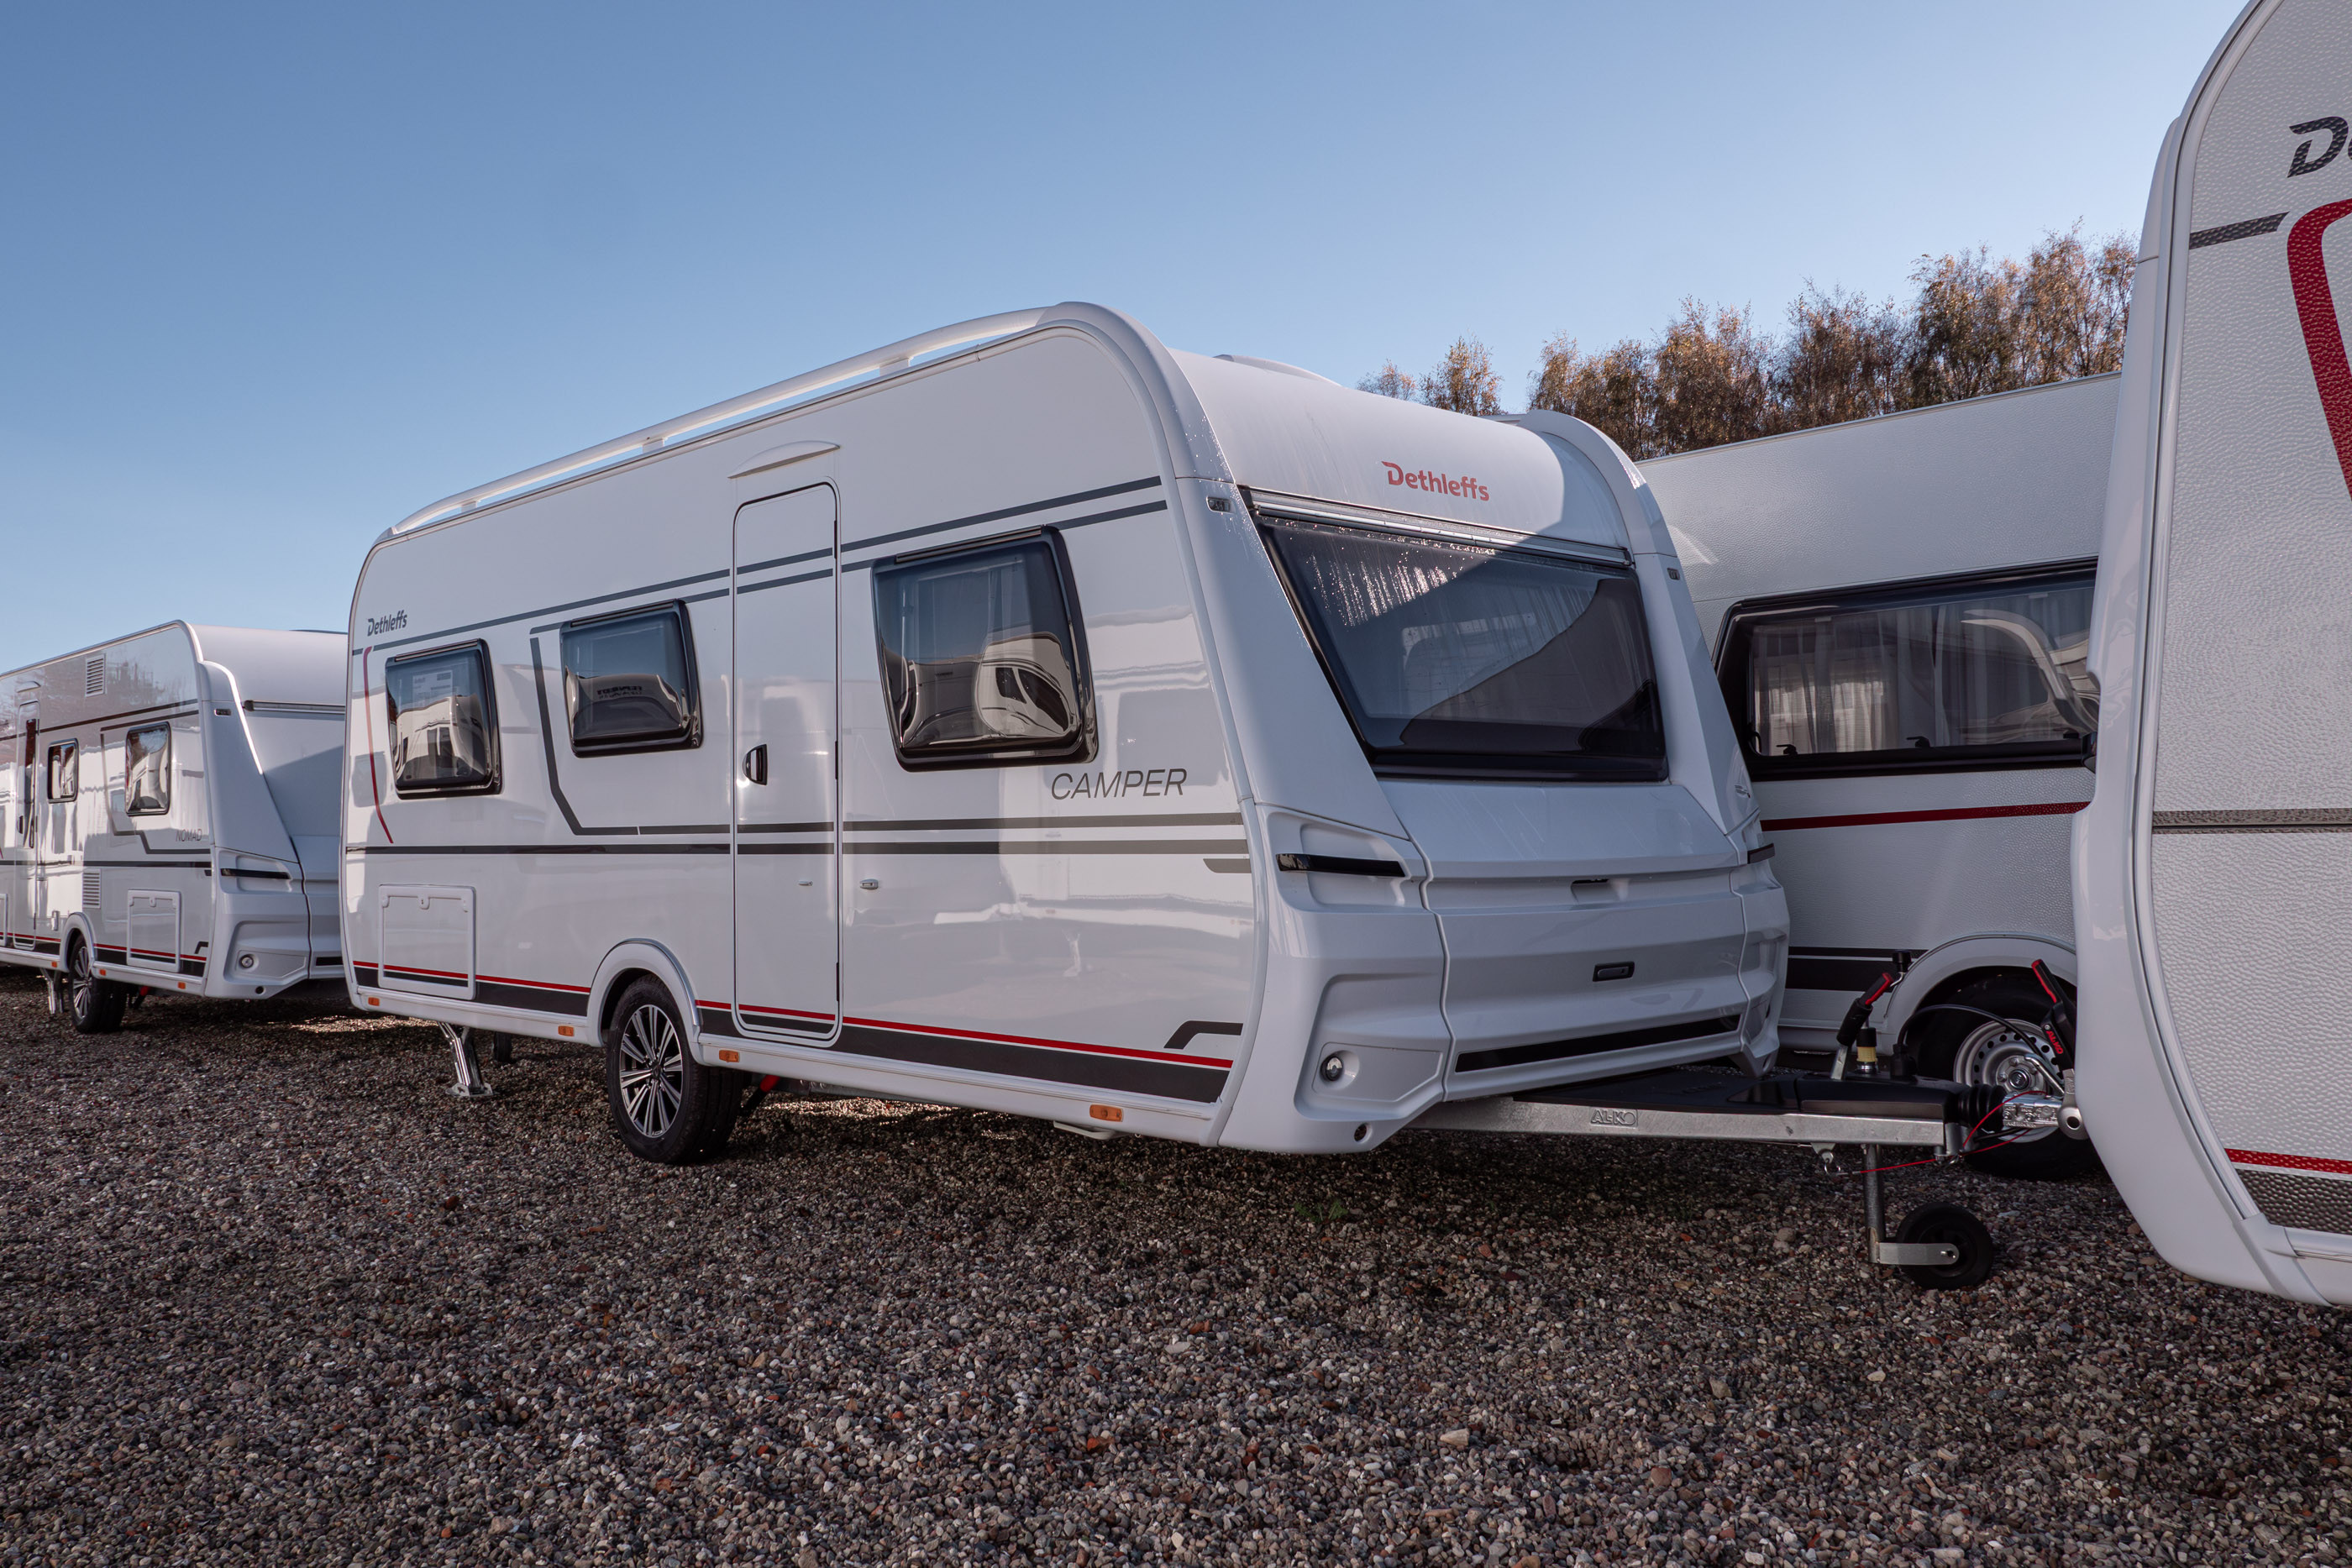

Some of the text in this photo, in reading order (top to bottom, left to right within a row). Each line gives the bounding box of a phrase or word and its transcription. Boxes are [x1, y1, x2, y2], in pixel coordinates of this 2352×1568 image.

[2286, 116, 2352, 178] D
[1381, 461, 1489, 501] Dethleffs
[367, 610, 407, 637] Dethleffs
[1052, 768, 1187, 800] CAMPER
[176, 828, 202, 842] NOMAD
